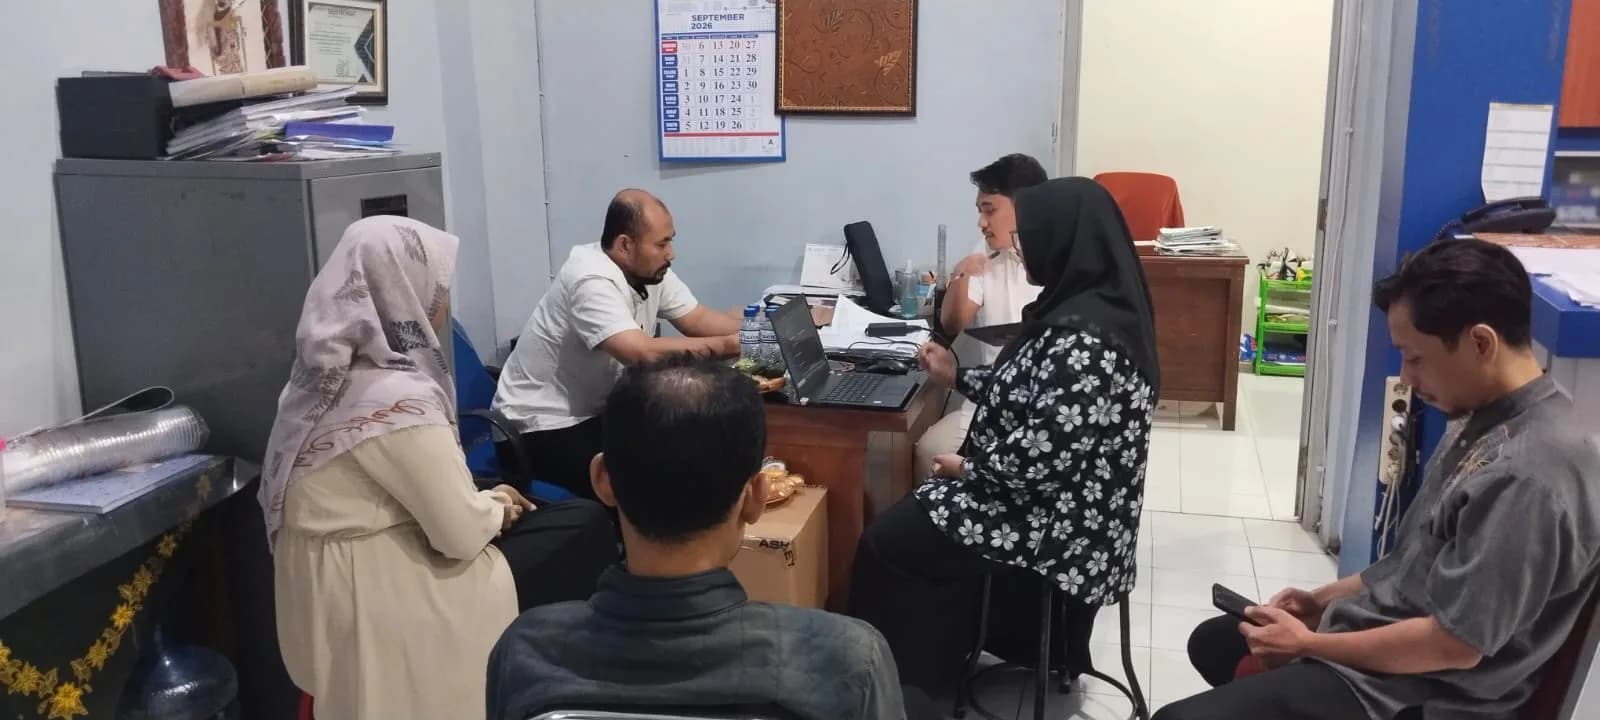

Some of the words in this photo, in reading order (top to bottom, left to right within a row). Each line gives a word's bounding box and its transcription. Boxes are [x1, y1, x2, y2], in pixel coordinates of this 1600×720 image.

[691, 14, 745, 22] SEPTEMBER
[699, 41, 705, 49] 6
[713, 41, 723, 49] 13
[729, 41, 740, 49] 20
[746, 40, 756, 49] 27
[699, 55, 705, 63] 7
[713, 55, 724, 63] 14
[730, 54, 740, 63] 21
[746, 54, 757, 62] 28
[684, 69, 688, 77] 1
[699, 68, 705, 76] 8
[714, 68, 724, 76] 15
[730, 68, 741, 76] 22
[747, 67, 757, 76] 29
[684, 82, 690, 90] 2
[700, 81, 705, 90] 9
[714, 81, 724, 90] 16
[731, 81, 741, 89] 23
[747, 81, 757, 89] 30
[685, 95, 690, 104] 3
[699, 95, 708, 103] 10
[715, 95, 724, 103] 17
[731, 94, 741, 103] 24
[685, 108, 690, 116] 4
[699, 108, 708, 116] 11
[715, 108, 725, 116] 18
[731, 107, 742, 116] 25
[686, 121, 691, 130] 5
[699, 121, 709, 129] 12
[716, 121, 726, 129] 19
[732, 121, 742, 129] 26
